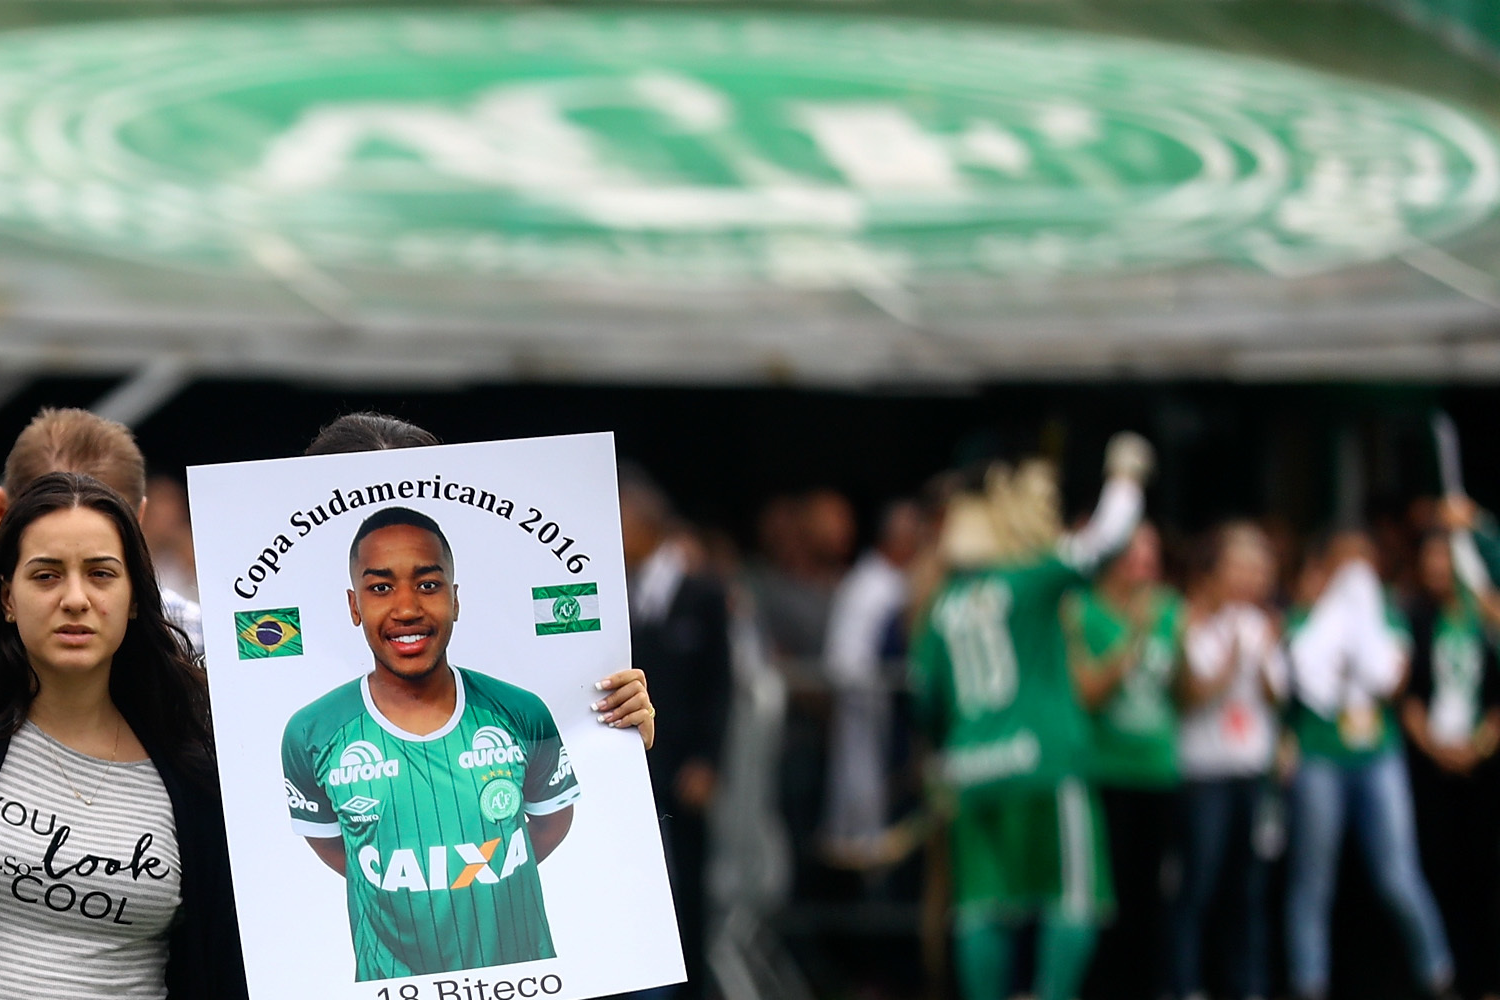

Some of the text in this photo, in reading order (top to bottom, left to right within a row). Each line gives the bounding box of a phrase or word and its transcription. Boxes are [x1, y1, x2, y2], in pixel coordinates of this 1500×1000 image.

[233, 475, 591, 600] Copa Sudamericana 2016
[328, 758, 399, 786] aurora
[548, 762, 573, 787] aur
[287, 795, 319, 813] ora
[349, 813, 380, 823] umbro
[42, 825, 171, 881] look
[357, 827, 529, 892] CAIXA
[11, 875, 133, 926] COOL
